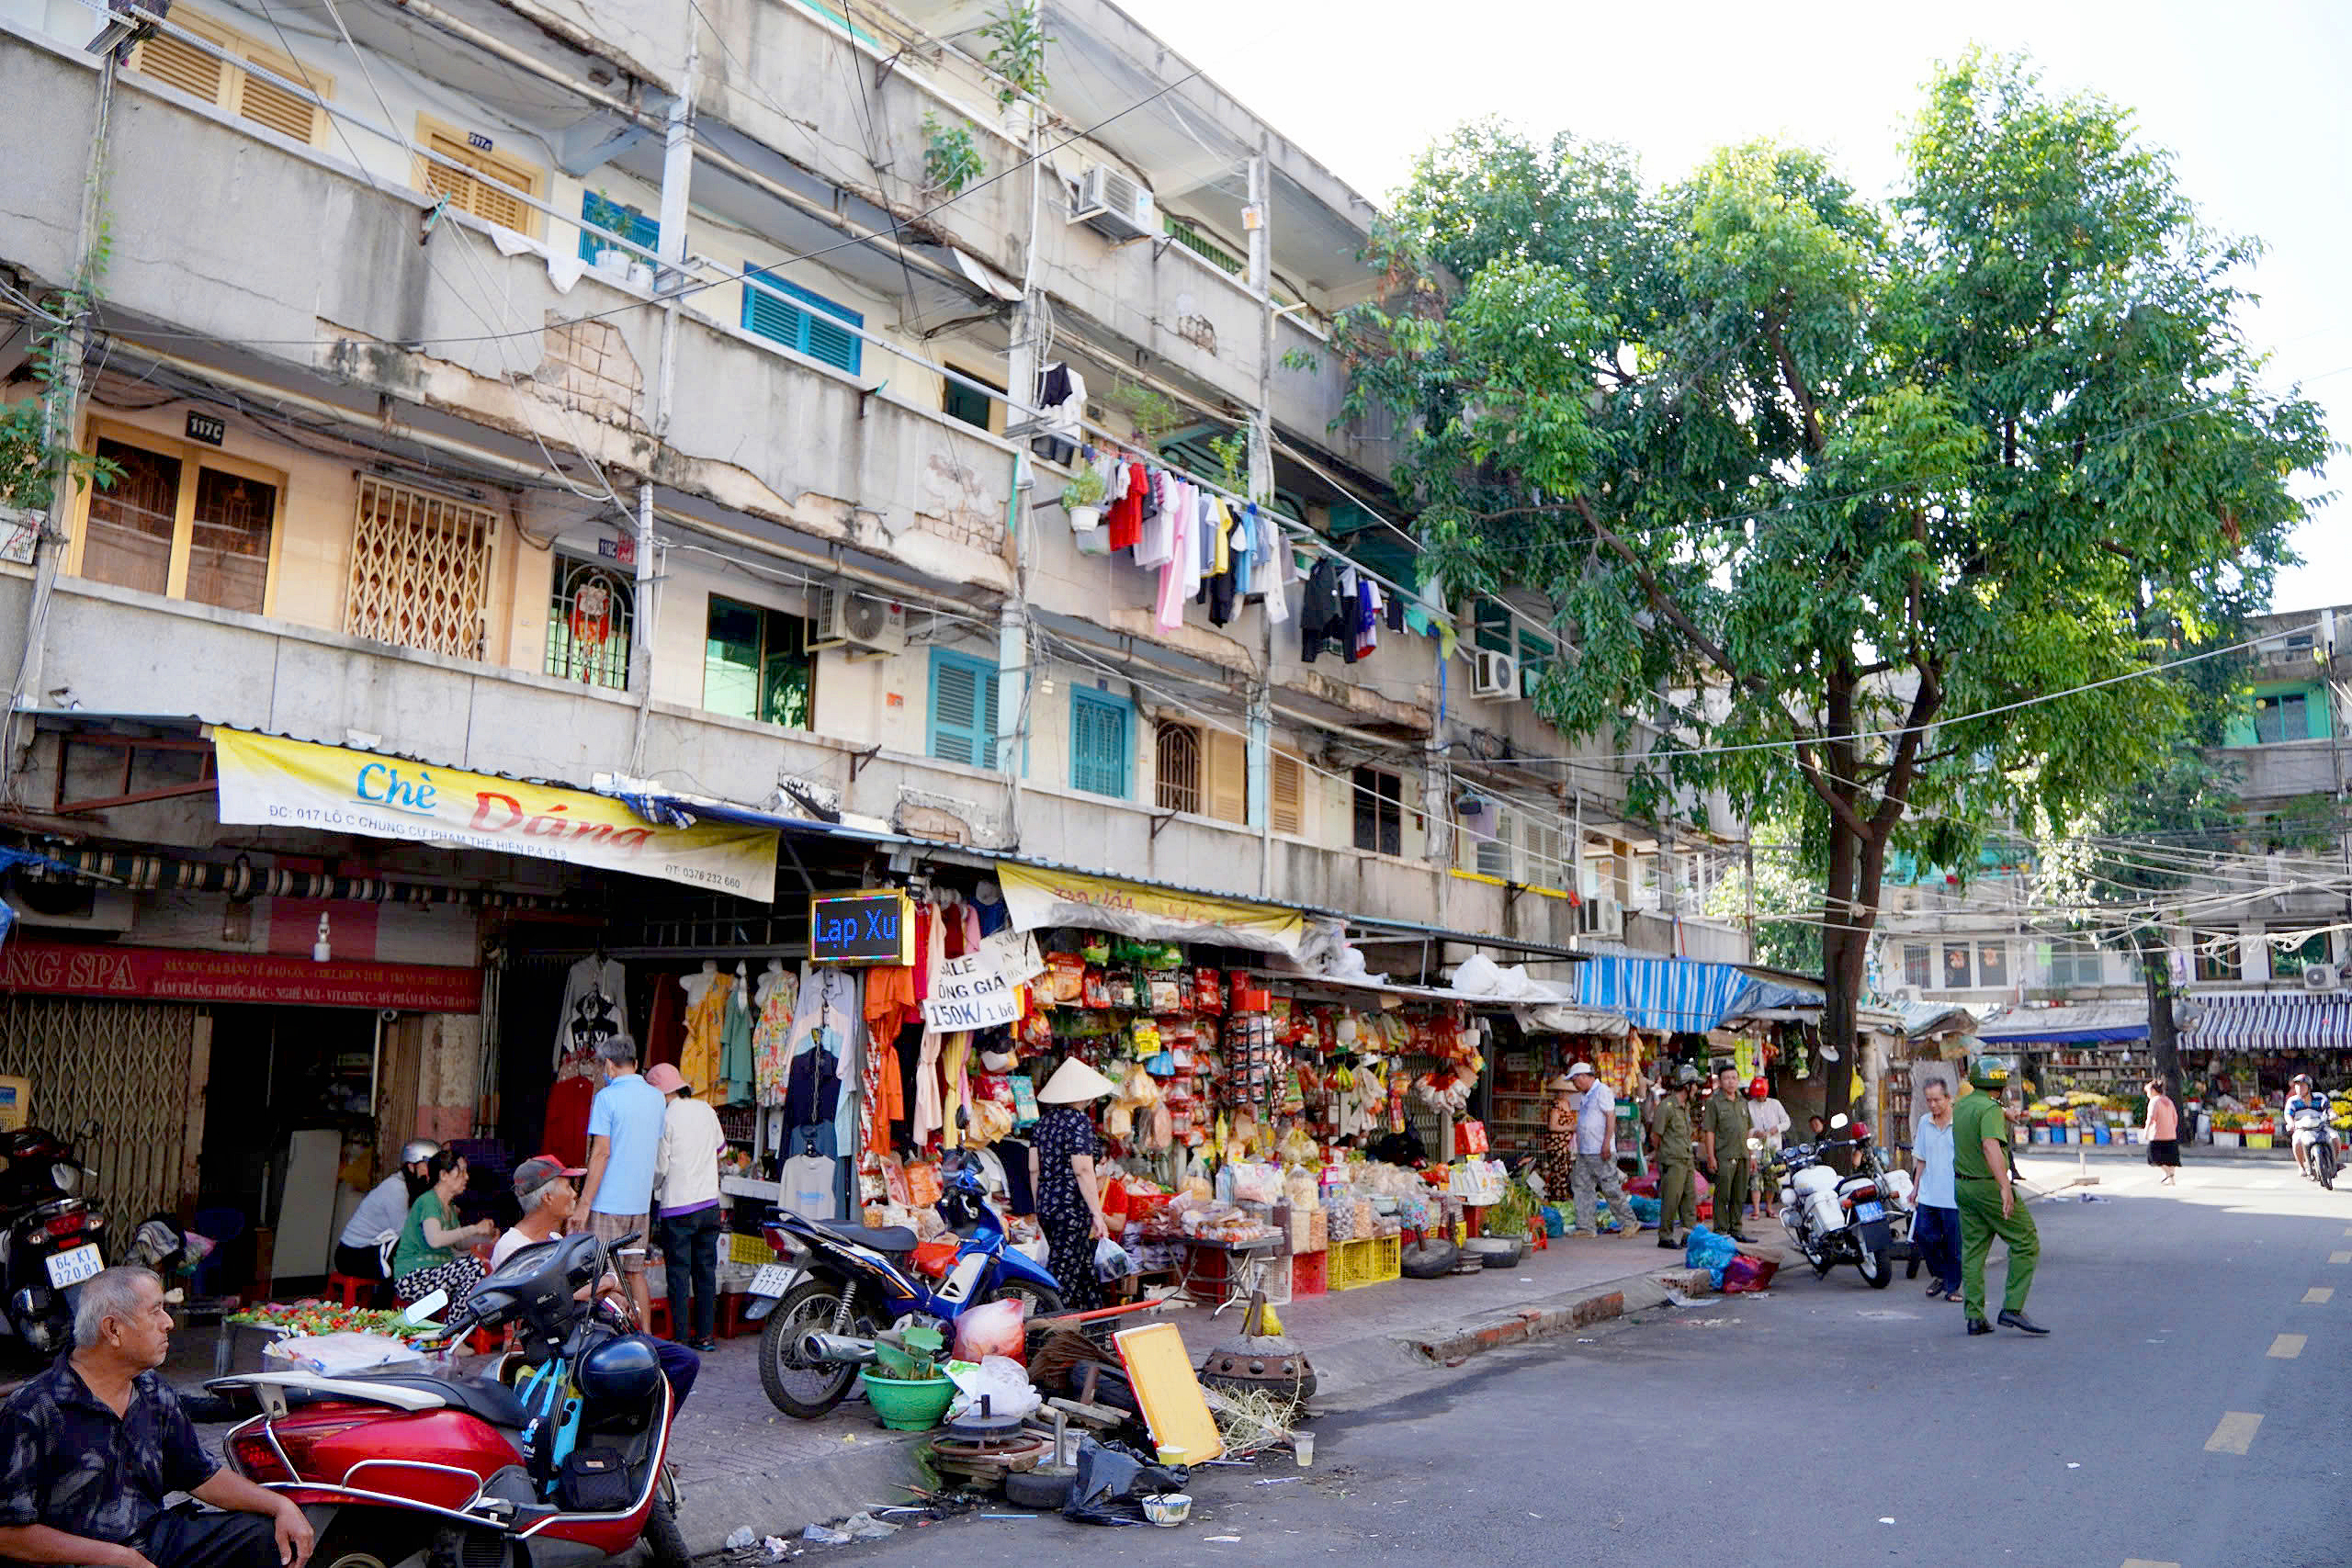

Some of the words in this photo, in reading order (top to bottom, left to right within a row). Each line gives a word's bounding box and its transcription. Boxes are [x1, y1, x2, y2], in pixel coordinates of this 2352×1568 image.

[191, 418, 221, 440] 117C
[297, 807, 320, 821] 017
[346, 815, 355, 825] C
[359, 817, 405, 834] CHUNG
[356, 762, 437, 809] Chè
[469, 791, 656, 858] Dáng
[814, 912, 859, 948] Lạp
[865, 908, 898, 941] Xu
[67, 953, 137, 990] SPA
[974, 970, 1007, 995] GIÁ
[55, 1248, 91, 1269] 64-K1
